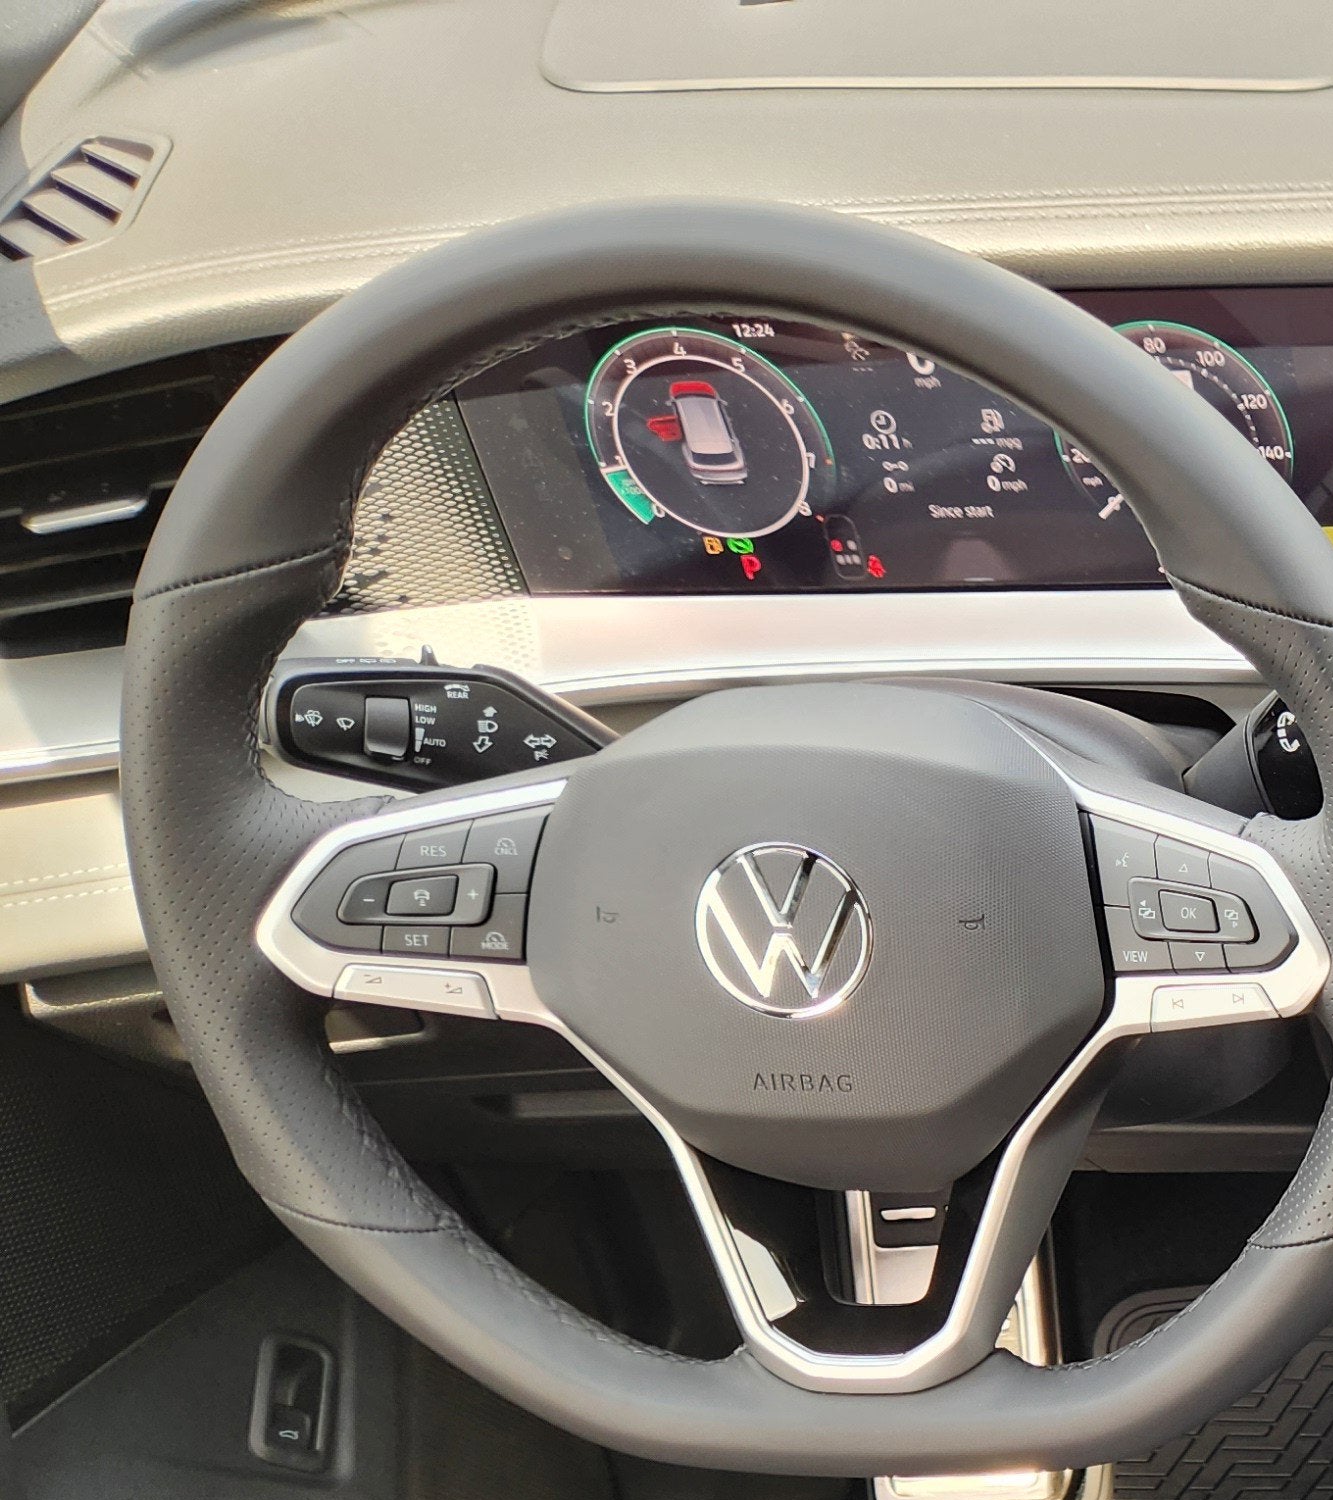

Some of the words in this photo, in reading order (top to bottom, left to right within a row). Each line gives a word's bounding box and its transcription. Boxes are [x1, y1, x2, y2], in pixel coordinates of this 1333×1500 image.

[731, 323, 775, 338] 12:24
[673, 342, 687, 356] 4
[1142, 336, 1167, 354] 80
[731, 357, 746, 373] 5
[1195, 350, 1226, 368] 100
[623, 359, 638, 376] 3
[601, 401, 615, 417] 2
[1241, 393, 1268, 410] 120
[862, 433, 900, 450] 0:11
[1258, 445, 1285, 460] 140
[883, 476, 898, 494] 0
[986, 474, 1001, 492] 0
[928, 503, 964, 519] Since
[965, 504, 996, 519] start
[740, 554, 762, 580] P
[446, 690, 470, 700] REAR
[414, 703, 438, 714] HIGH
[415, 715, 436, 726] LOW
[423, 736, 447, 748] AUTO
[413, 756, 433, 766] OFF
[420, 845, 447, 858] RES
[1180, 906, 1197, 920] OK
[404, 934, 429, 947] SET
[1123, 950, 1148, 963] VIEW
[753, 1072, 853, 1094] AIRBAG
